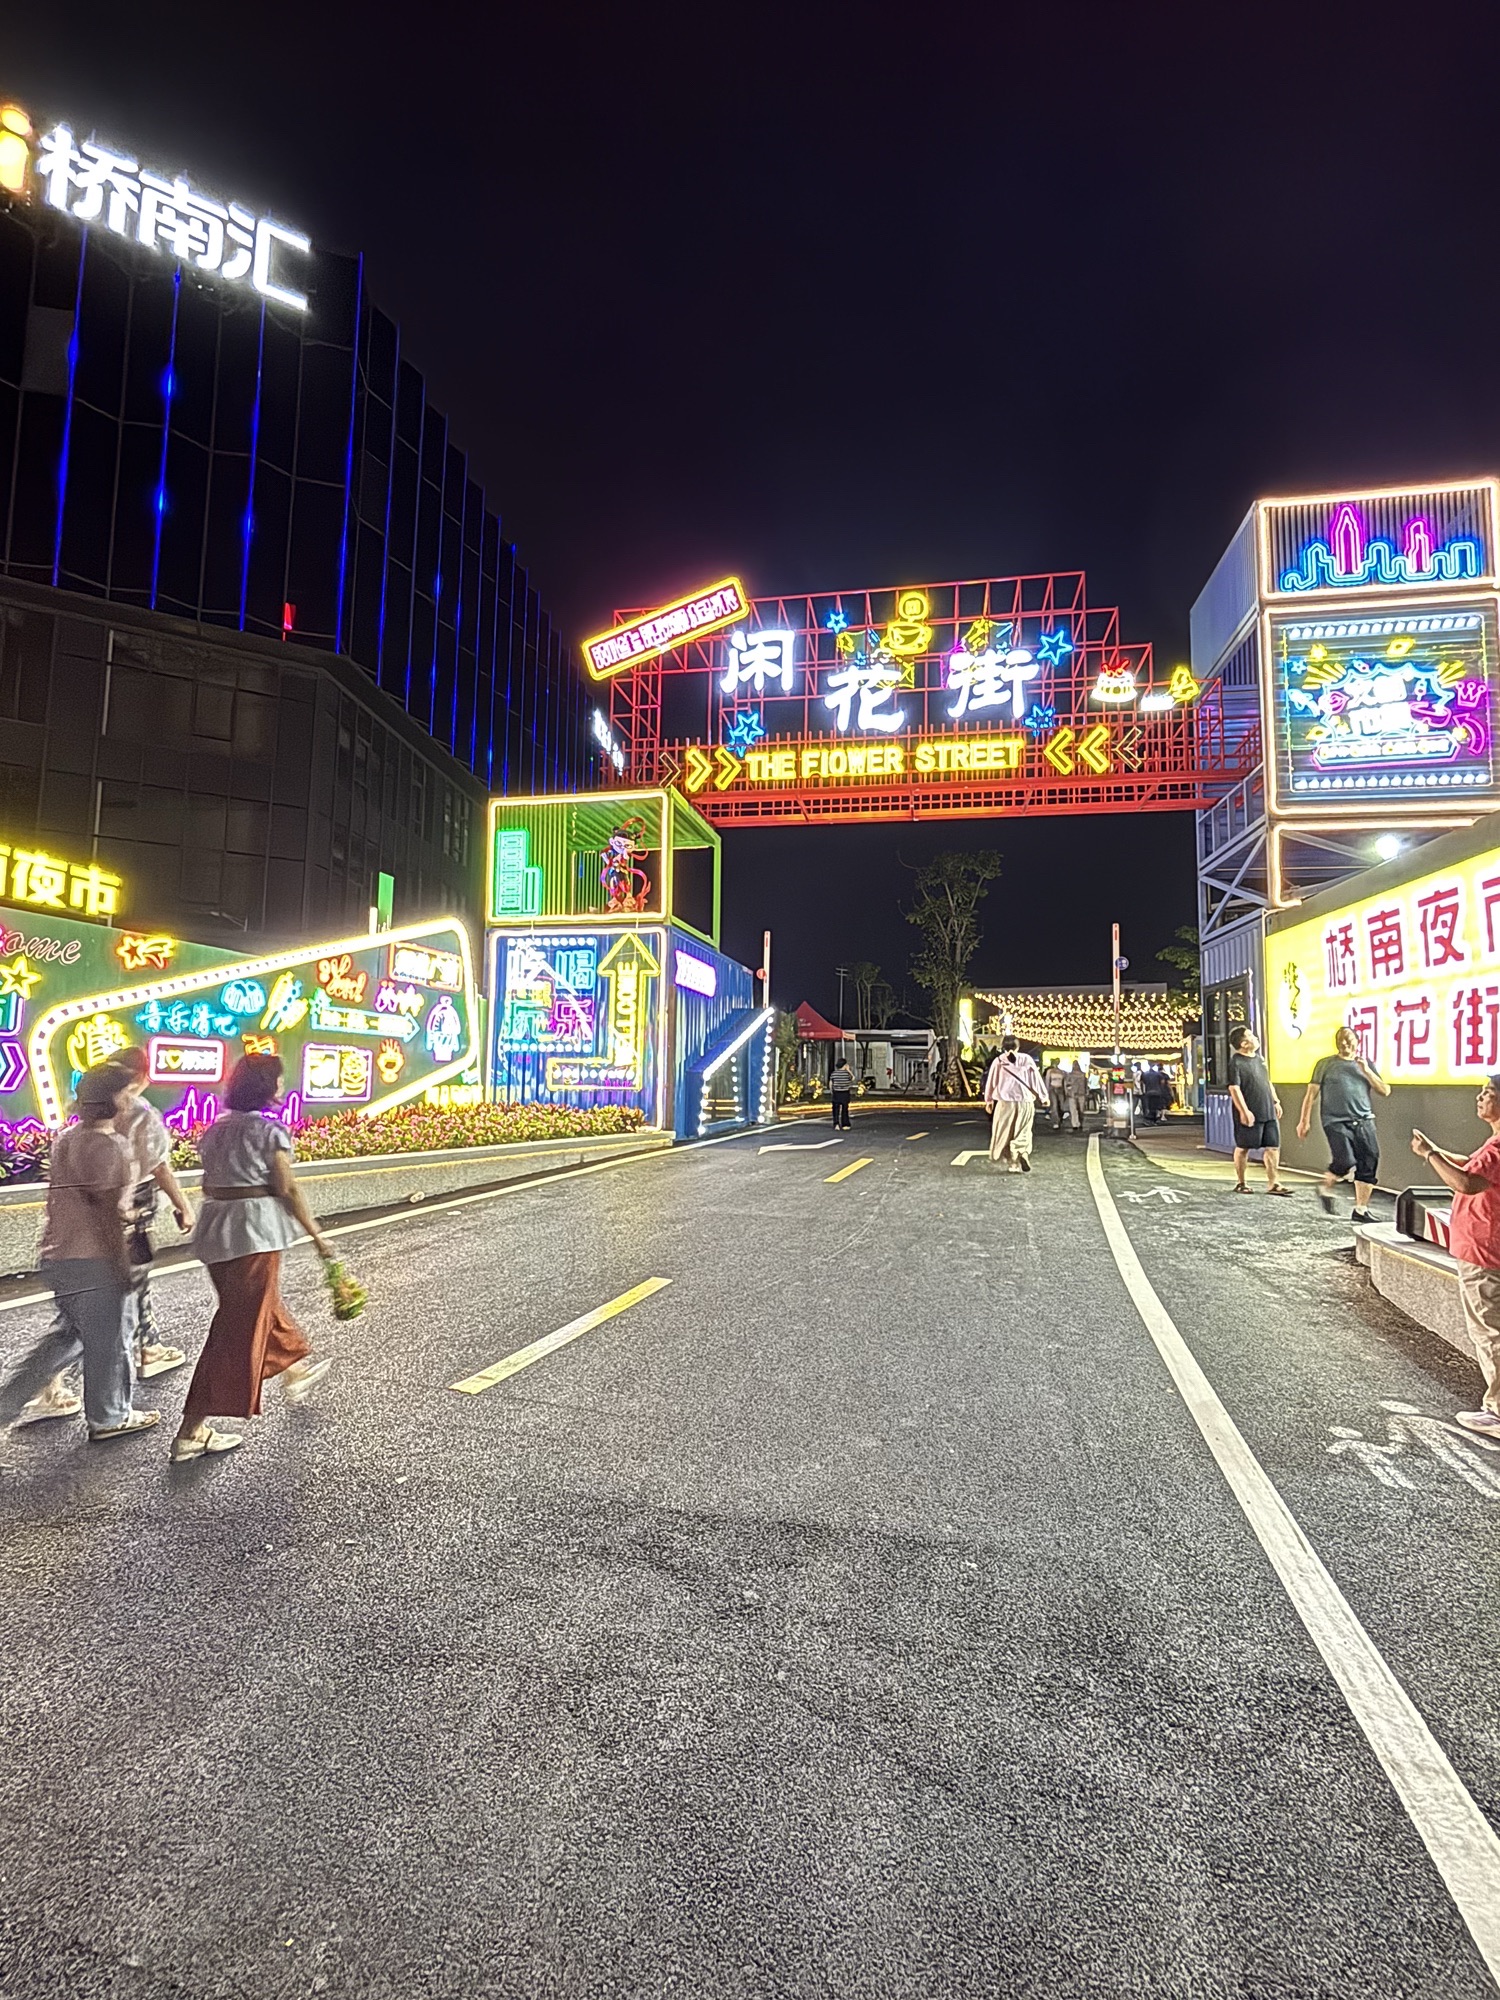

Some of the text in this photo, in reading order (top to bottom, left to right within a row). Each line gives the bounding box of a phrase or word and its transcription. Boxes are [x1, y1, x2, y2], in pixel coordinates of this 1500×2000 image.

[38, 122, 312, 313] 桥南汇
[720, 629, 1040, 733] 闲花街
[745, 750, 796, 781] THE
[915, 738, 1025, 773] STREET
[0, 843, 121, 916] 夜市
